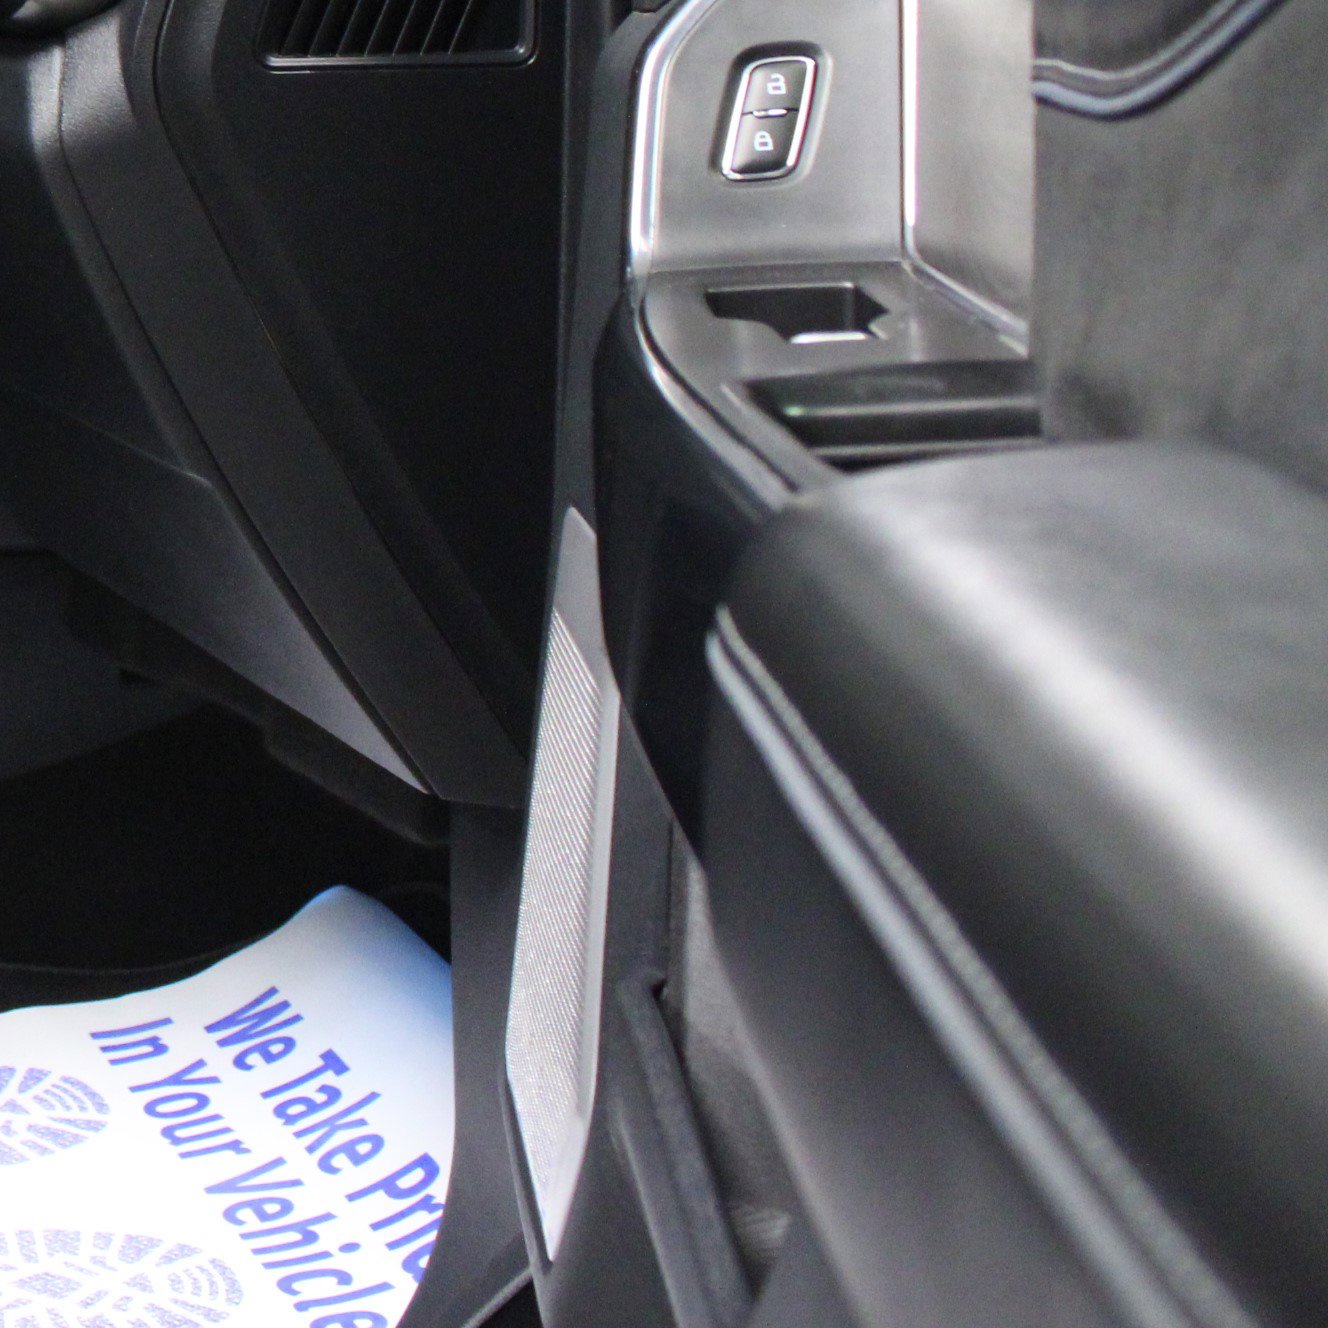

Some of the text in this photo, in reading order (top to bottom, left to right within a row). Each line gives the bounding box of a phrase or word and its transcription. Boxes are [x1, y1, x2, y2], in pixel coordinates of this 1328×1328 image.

[88, 1016, 175, 1067] In
[203, 985, 305, 1072] We
[258, 1047, 386, 1176] Take
[127, 1057, 253, 1160] Your
